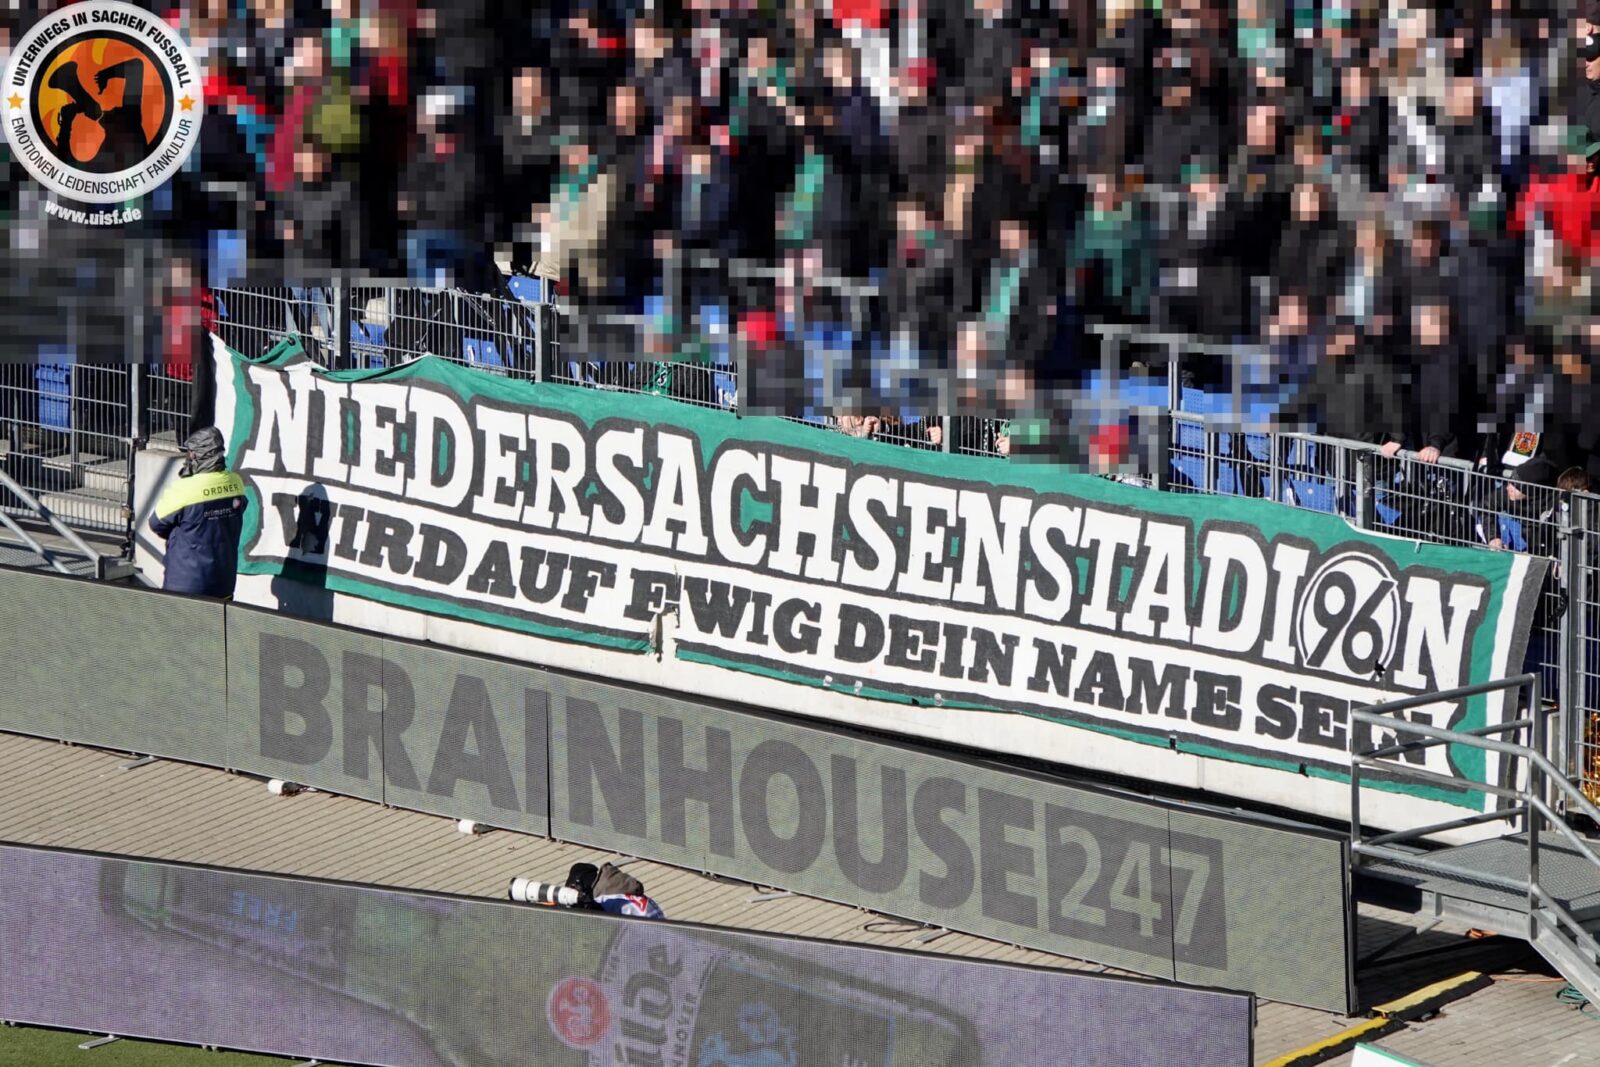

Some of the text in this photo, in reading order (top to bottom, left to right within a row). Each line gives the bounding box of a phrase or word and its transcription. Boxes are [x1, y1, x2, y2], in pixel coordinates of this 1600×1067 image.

[204, 484, 239, 496] ORDNER
[271, 491, 468, 586] WIRD
[467, 539, 616, 614] AUF
[623, 567, 822, 655] EWIG
[834, 603, 1019, 687] DEIN
[1027, 637, 1242, 732] NAME
[258, 631, 1212, 946] BRAINHOUSE247
